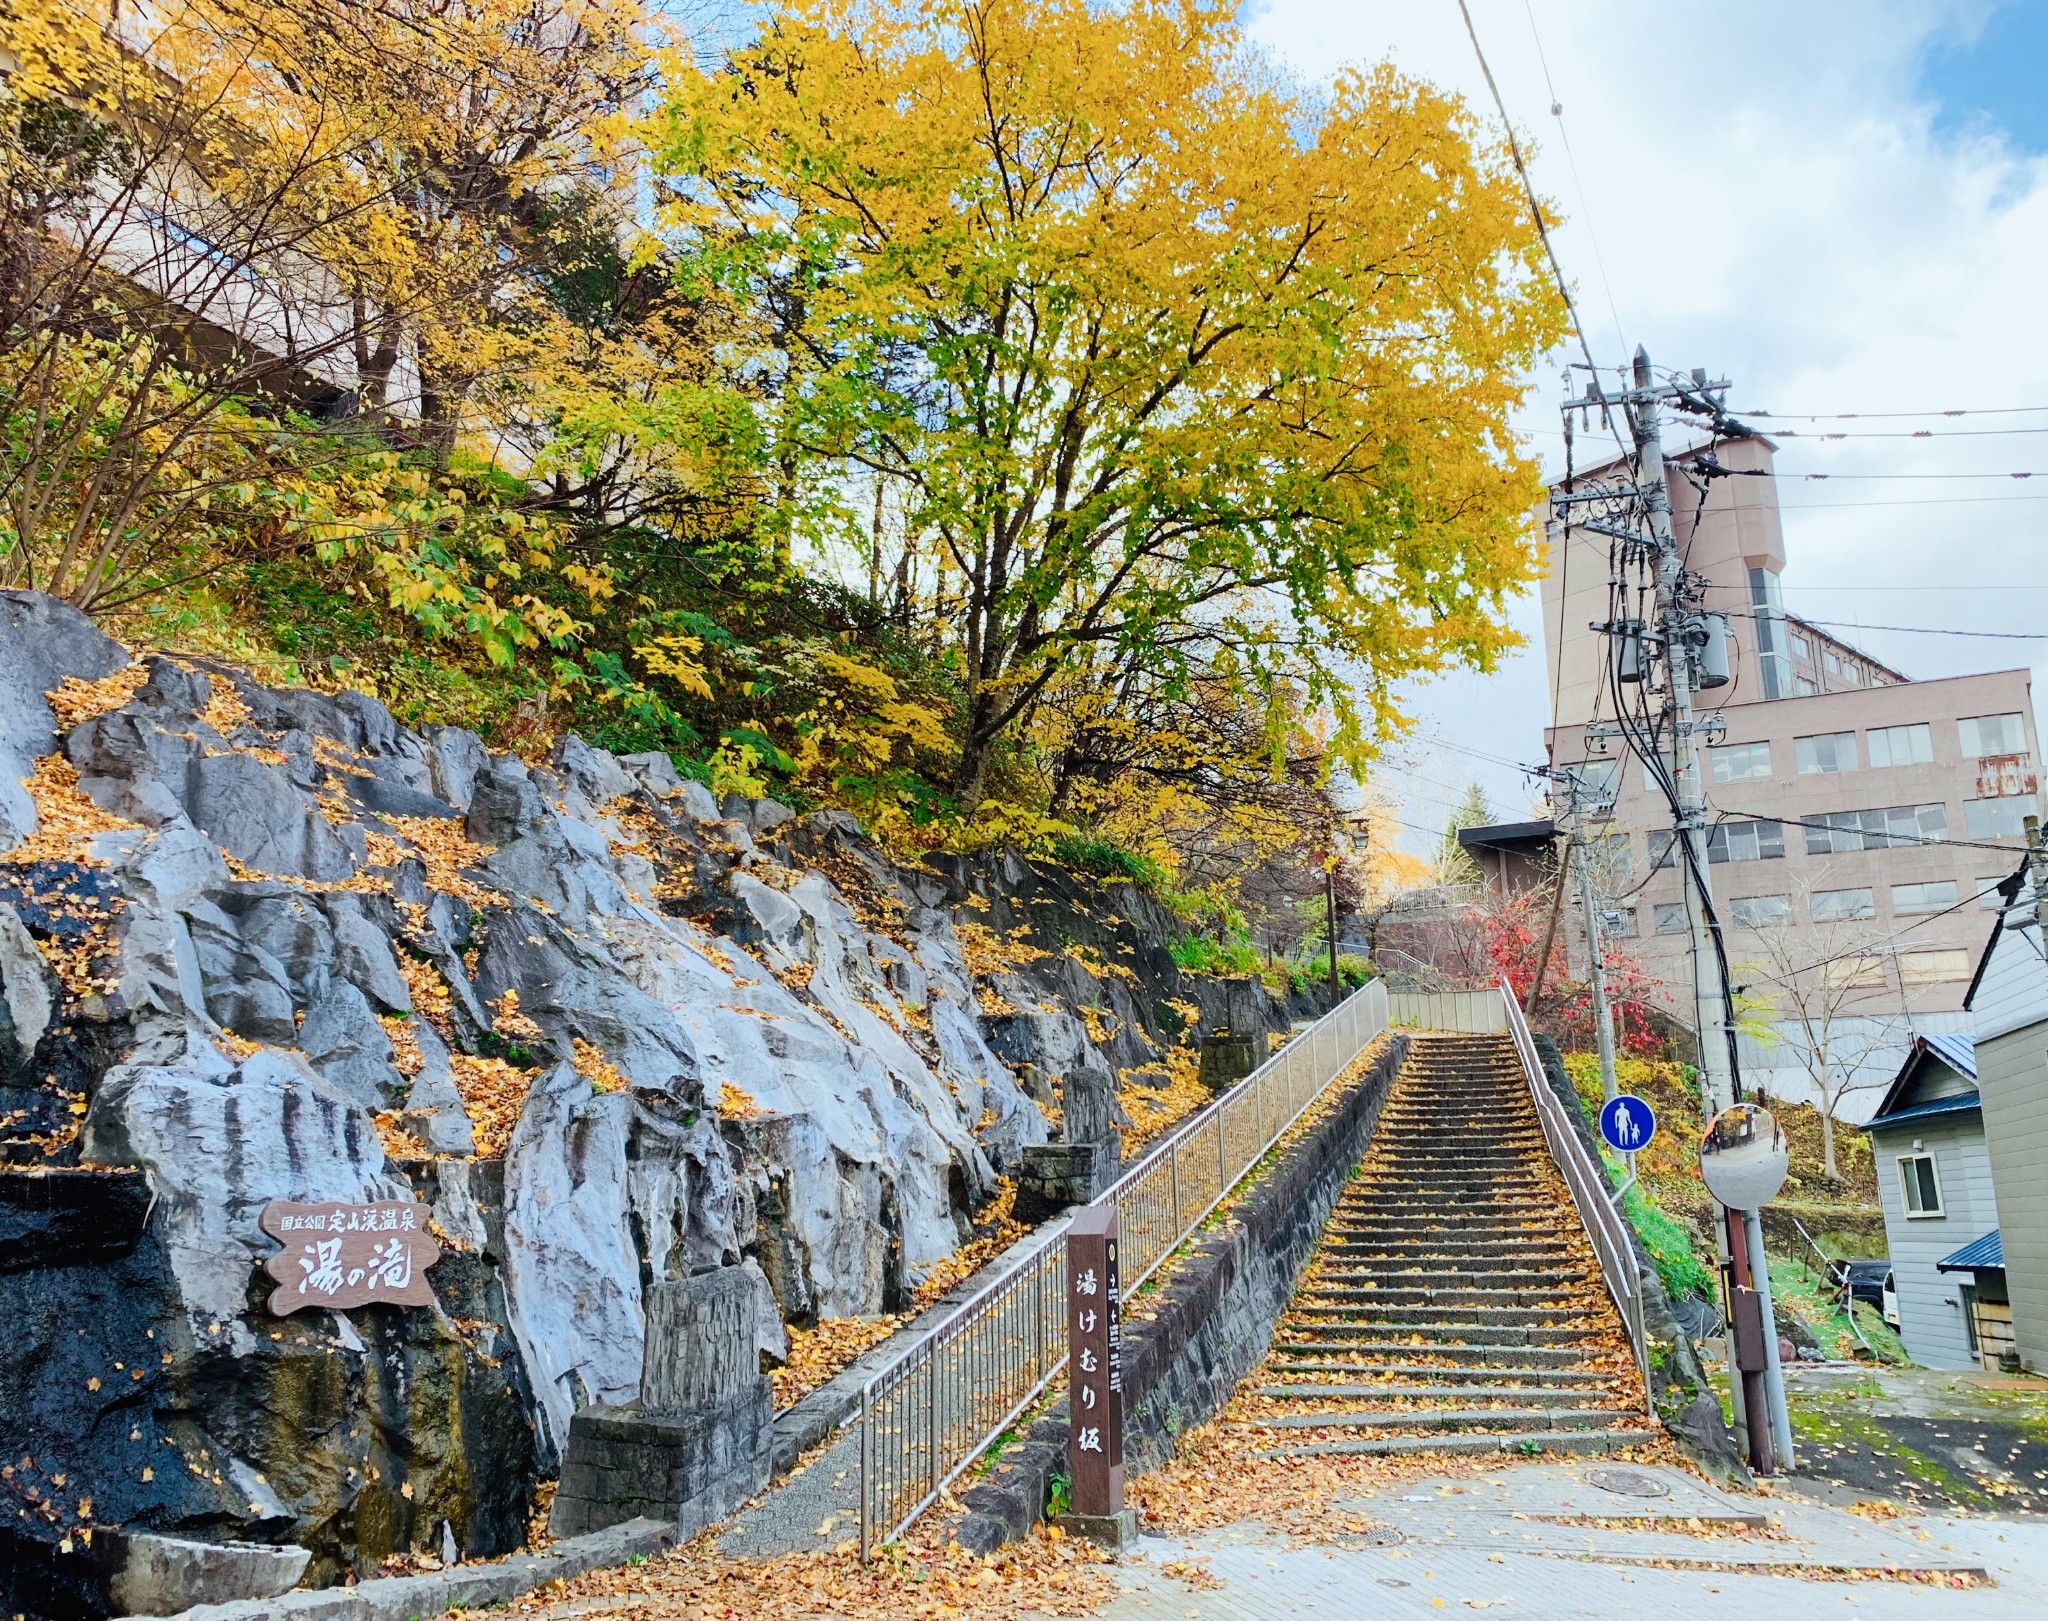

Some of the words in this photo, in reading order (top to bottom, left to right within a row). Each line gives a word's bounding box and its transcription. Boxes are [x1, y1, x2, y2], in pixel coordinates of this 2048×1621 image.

[1076, 1268, 1103, 1453] 湯けむり坂
